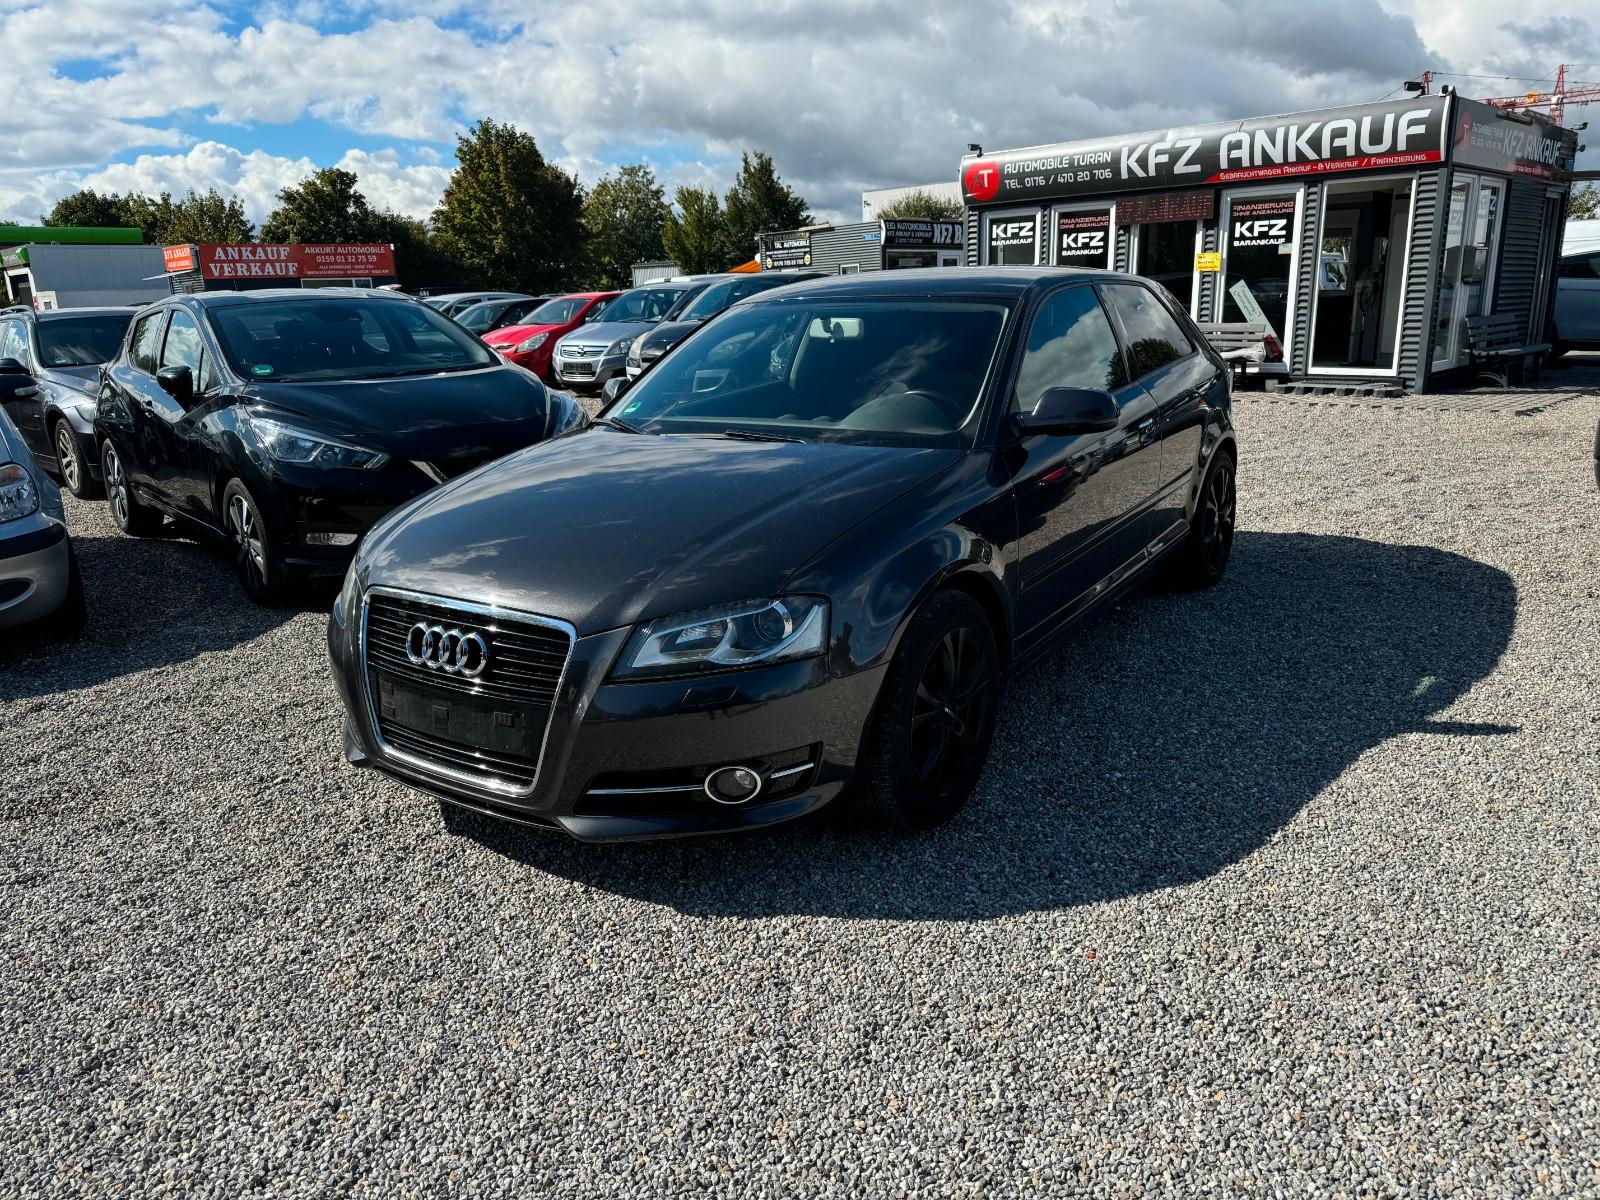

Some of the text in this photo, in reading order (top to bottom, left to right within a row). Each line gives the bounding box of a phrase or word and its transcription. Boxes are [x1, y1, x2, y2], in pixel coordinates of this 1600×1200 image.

[1120, 108, 1432, 180] KFZ ANKAUF
[1502, 128, 1525, 158] KFZ
[1524, 134, 1562, 166] ANKAUF
[1004, 151, 1112, 174] AUTOMOBILE TURAN
[1004, 168, 1112, 190] TEL. 0176 / 470 20 706
[1233, 201, 1294, 211] FINANZIERUNG
[1060, 215, 1109, 224] FINANZIERUNG
[1076, 221, 1109, 229] ANZAHLUNG
[897, 222, 932, 231] AUTOMOBILE
[992, 222, 1034, 239] KFZ
[1234, 219, 1287, 238] KFZ
[954, 224, 964, 244] B
[1063, 231, 1104, 249] KFZ
[784, 239, 810, 248] AUTOMOBILE
[991, 238, 1033, 246] BARANKAUF
[1233, 238, 1286, 247] BARANKAUF
[214, 247, 289, 260] ANKAUF
[337, 246, 385, 254] AUTOMOBILE
[316, 255, 377, 263] 0159 01 32 75 59
[209, 262, 299, 276] VERKAUF
